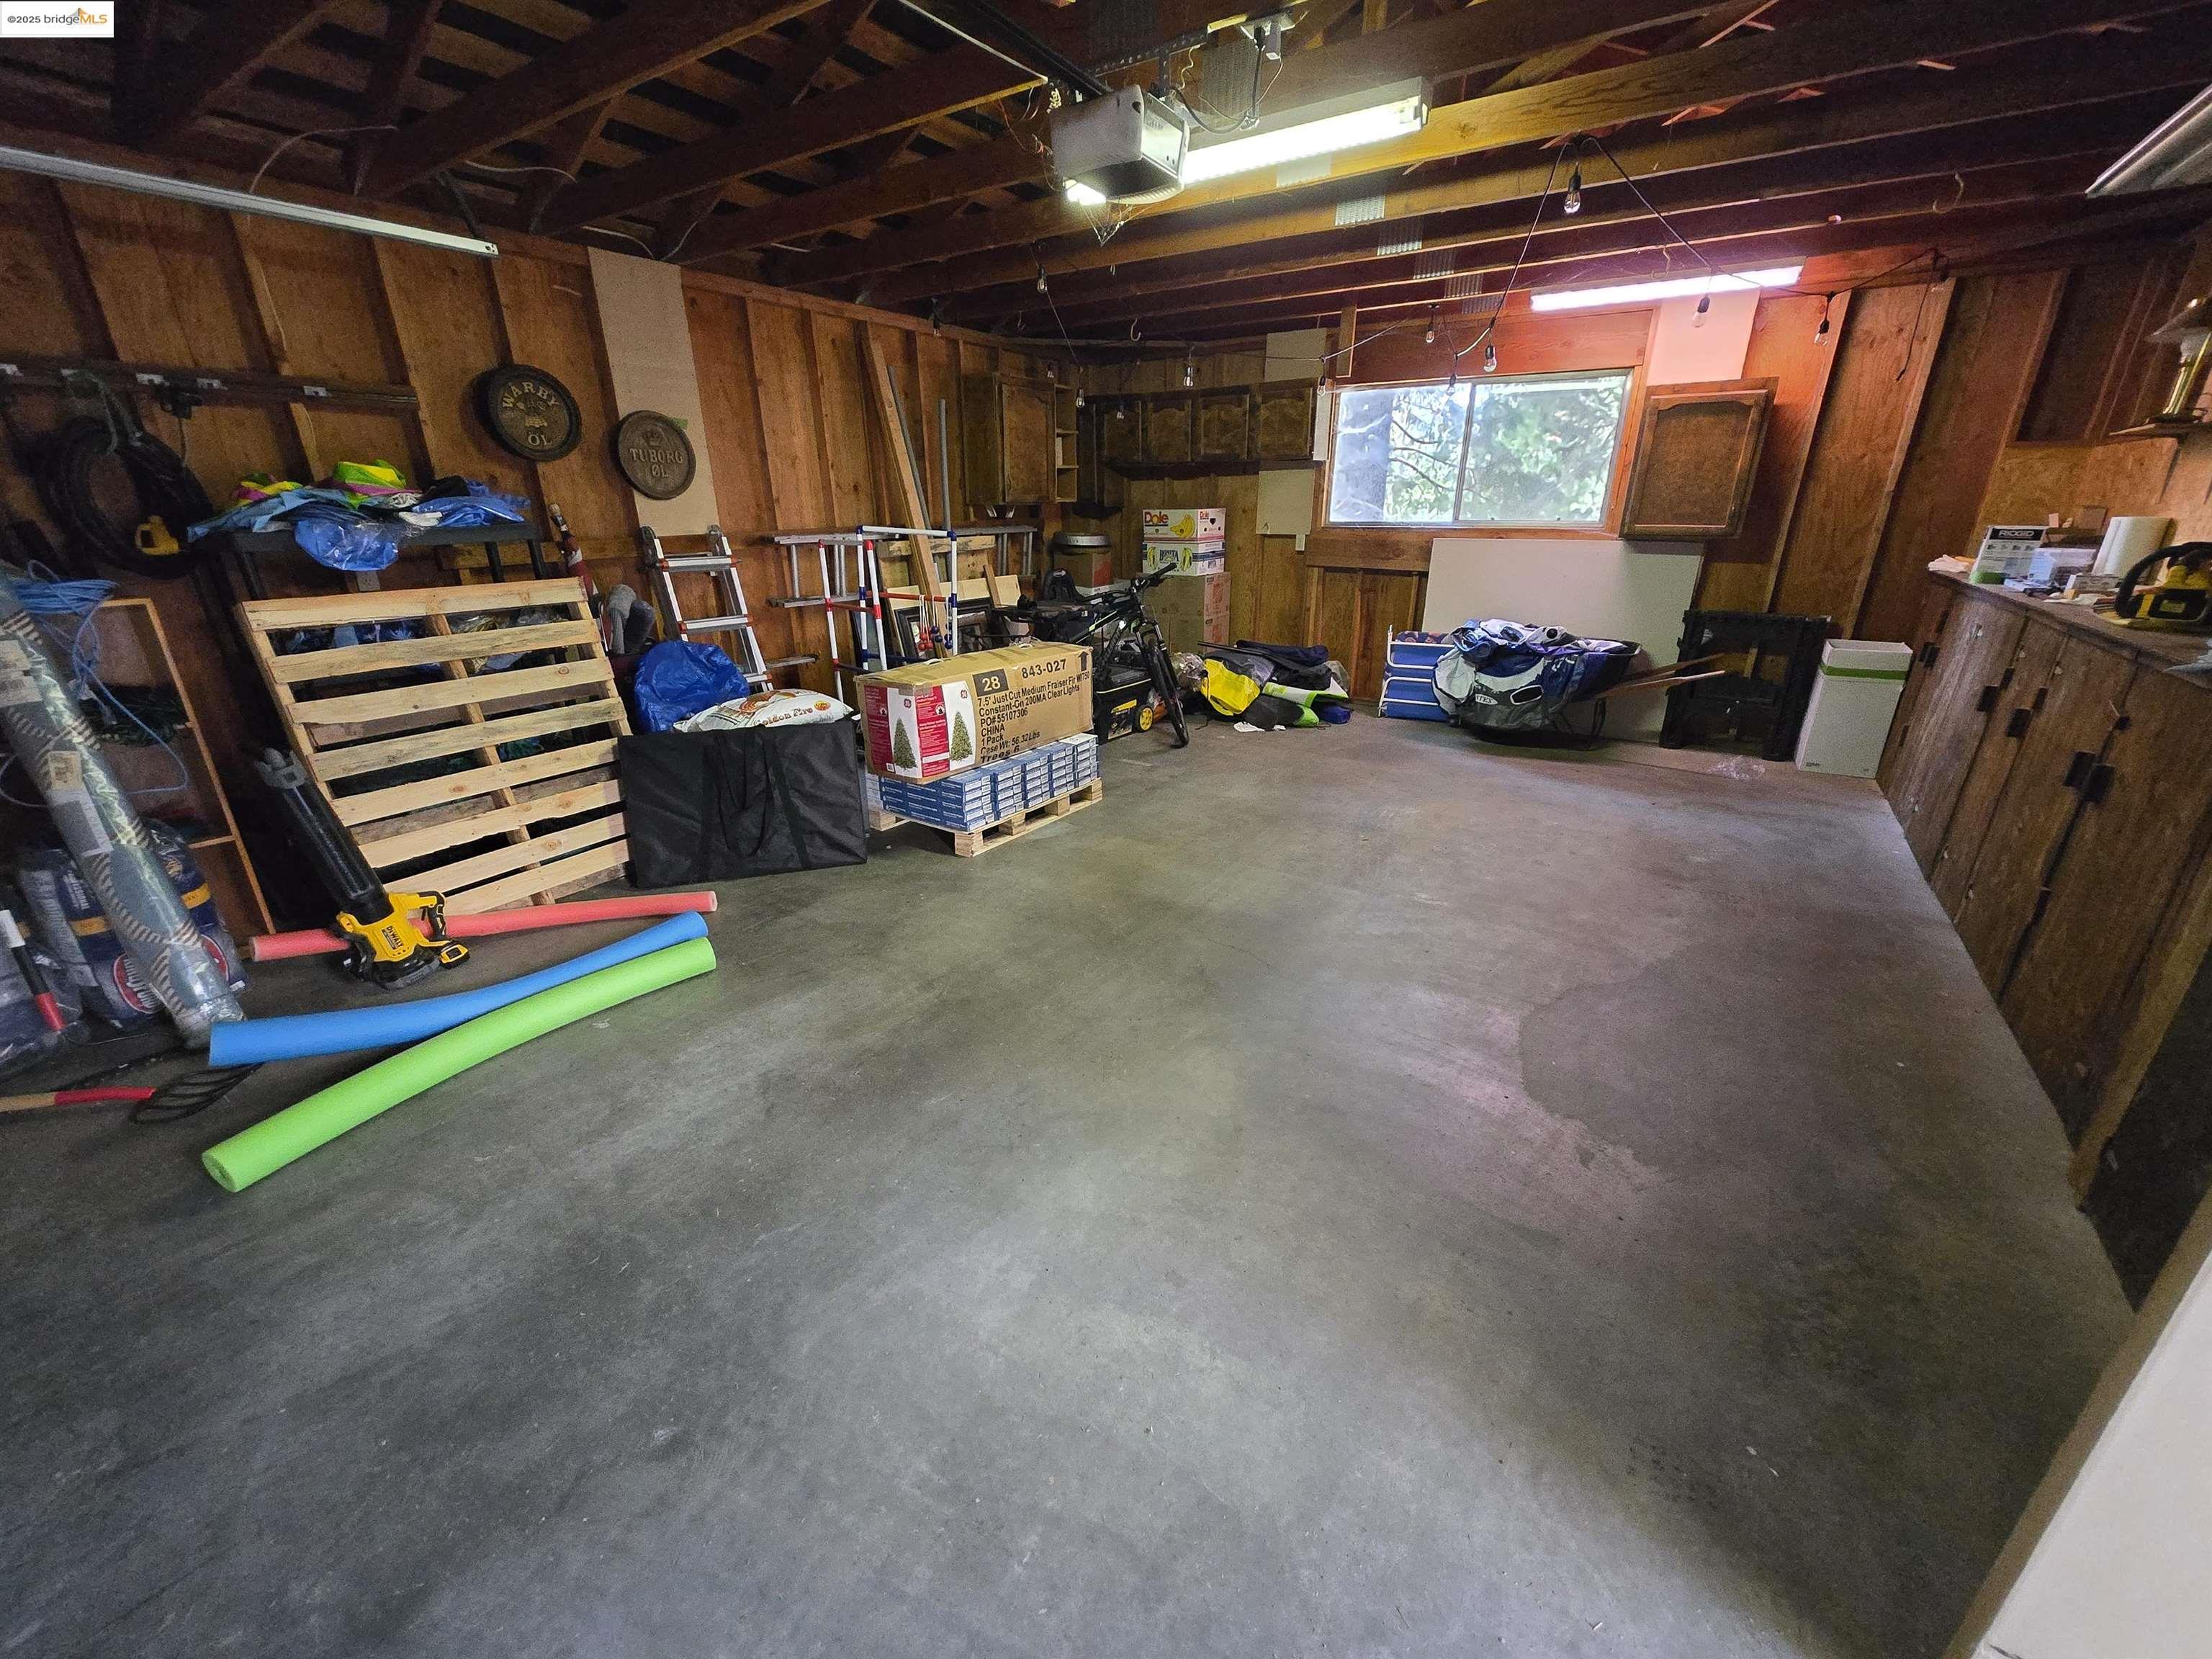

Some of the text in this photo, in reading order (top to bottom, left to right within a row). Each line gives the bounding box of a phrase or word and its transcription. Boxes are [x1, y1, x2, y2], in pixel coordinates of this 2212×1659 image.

[528, 432, 553, 446] ÖL
[629, 448, 683, 464] TUBORG
[1144, 511, 1169, 524] Dole
[1021, 659, 1066, 678] 843-027
[977, 696, 991, 707] 7.5'
[992, 693, 1008, 704] Just
[1008, 690, 1021, 701] Cut
[1021, 685, 1047, 697] Medium
[1047, 679, 1068, 690] Fraiser
[1068, 675, 1076, 685] Fir
[982, 675, 1001, 692] 28
[1047, 689, 1063, 699] Clear
[1063, 684, 1079, 696] Lights
[981, 723, 1005, 737] CHINA
[986, 733, 1004, 745] Pack
